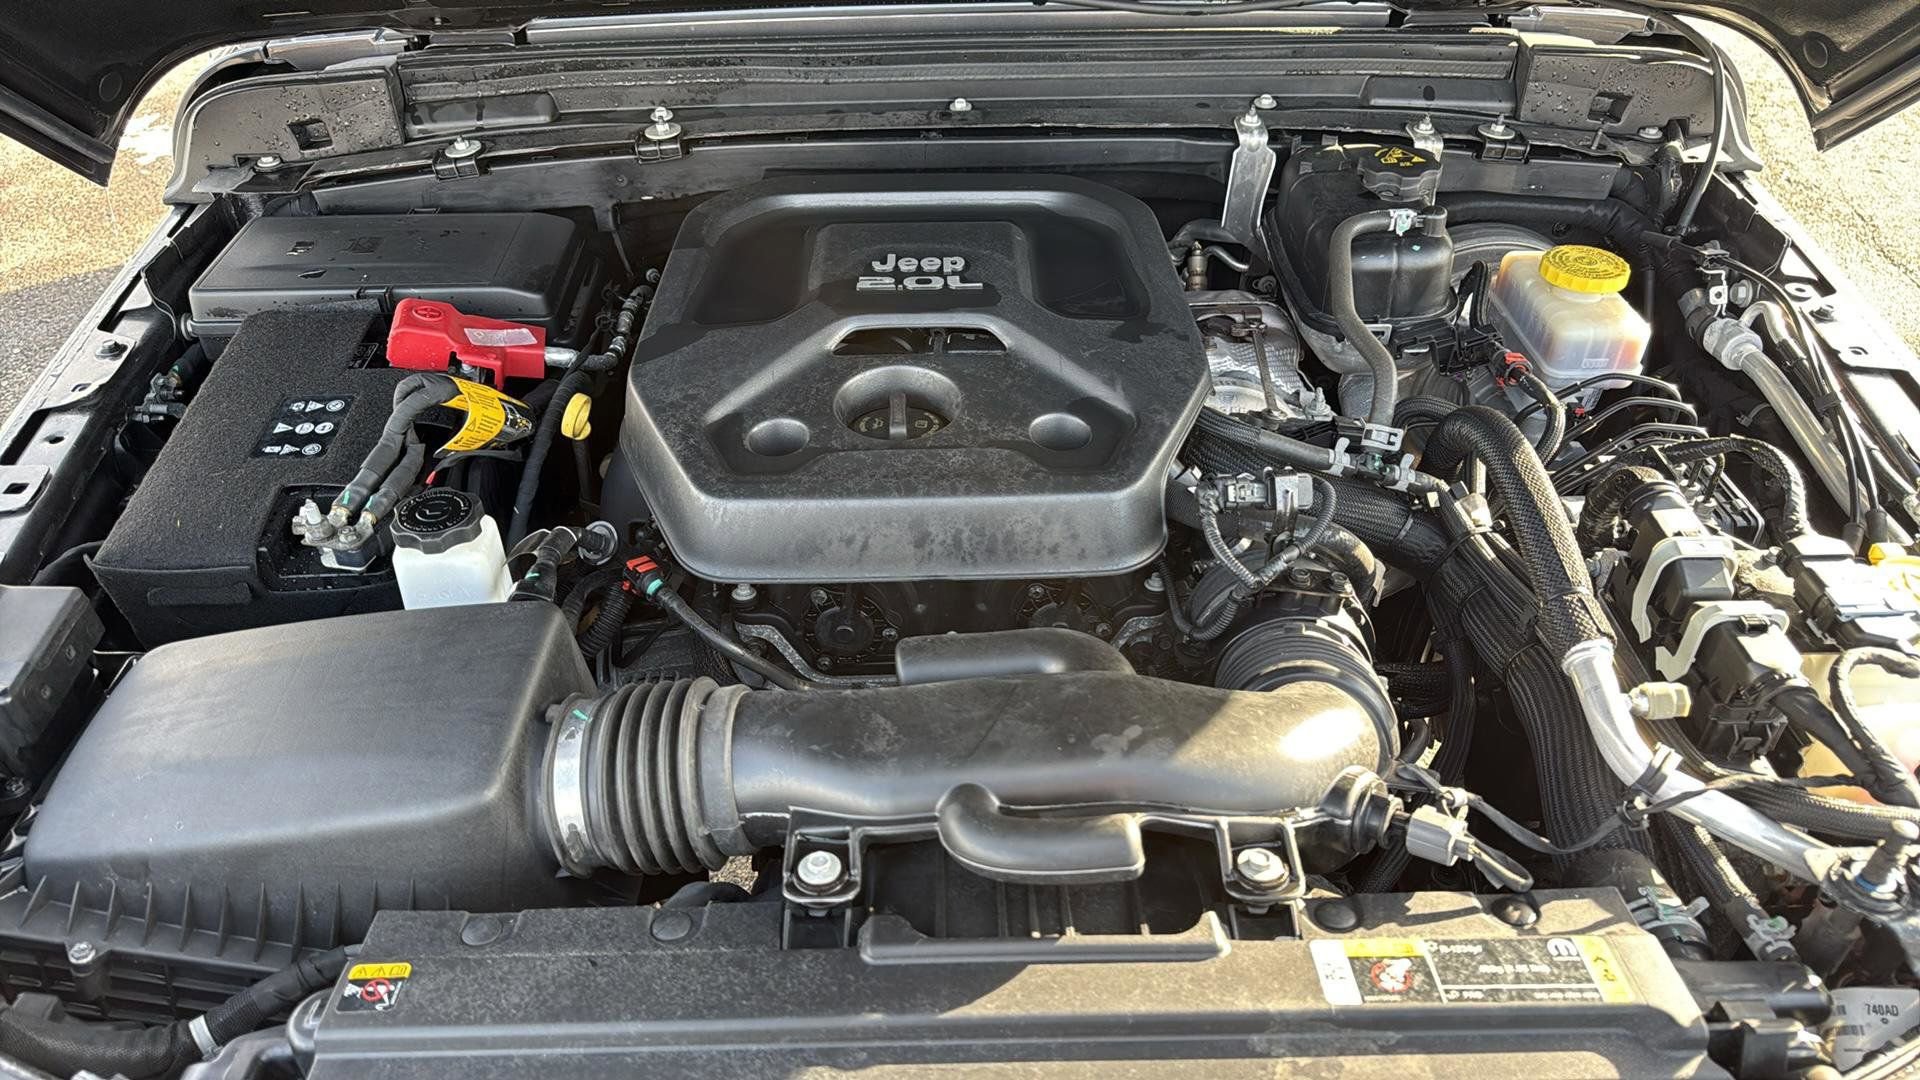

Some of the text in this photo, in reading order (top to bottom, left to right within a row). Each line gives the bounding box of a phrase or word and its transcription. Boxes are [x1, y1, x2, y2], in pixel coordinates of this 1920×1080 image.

[871, 253, 966, 275] Jeep
[856, 275, 984, 291] 2.0L
[1864, 1003, 1899, 1017] 740AD
